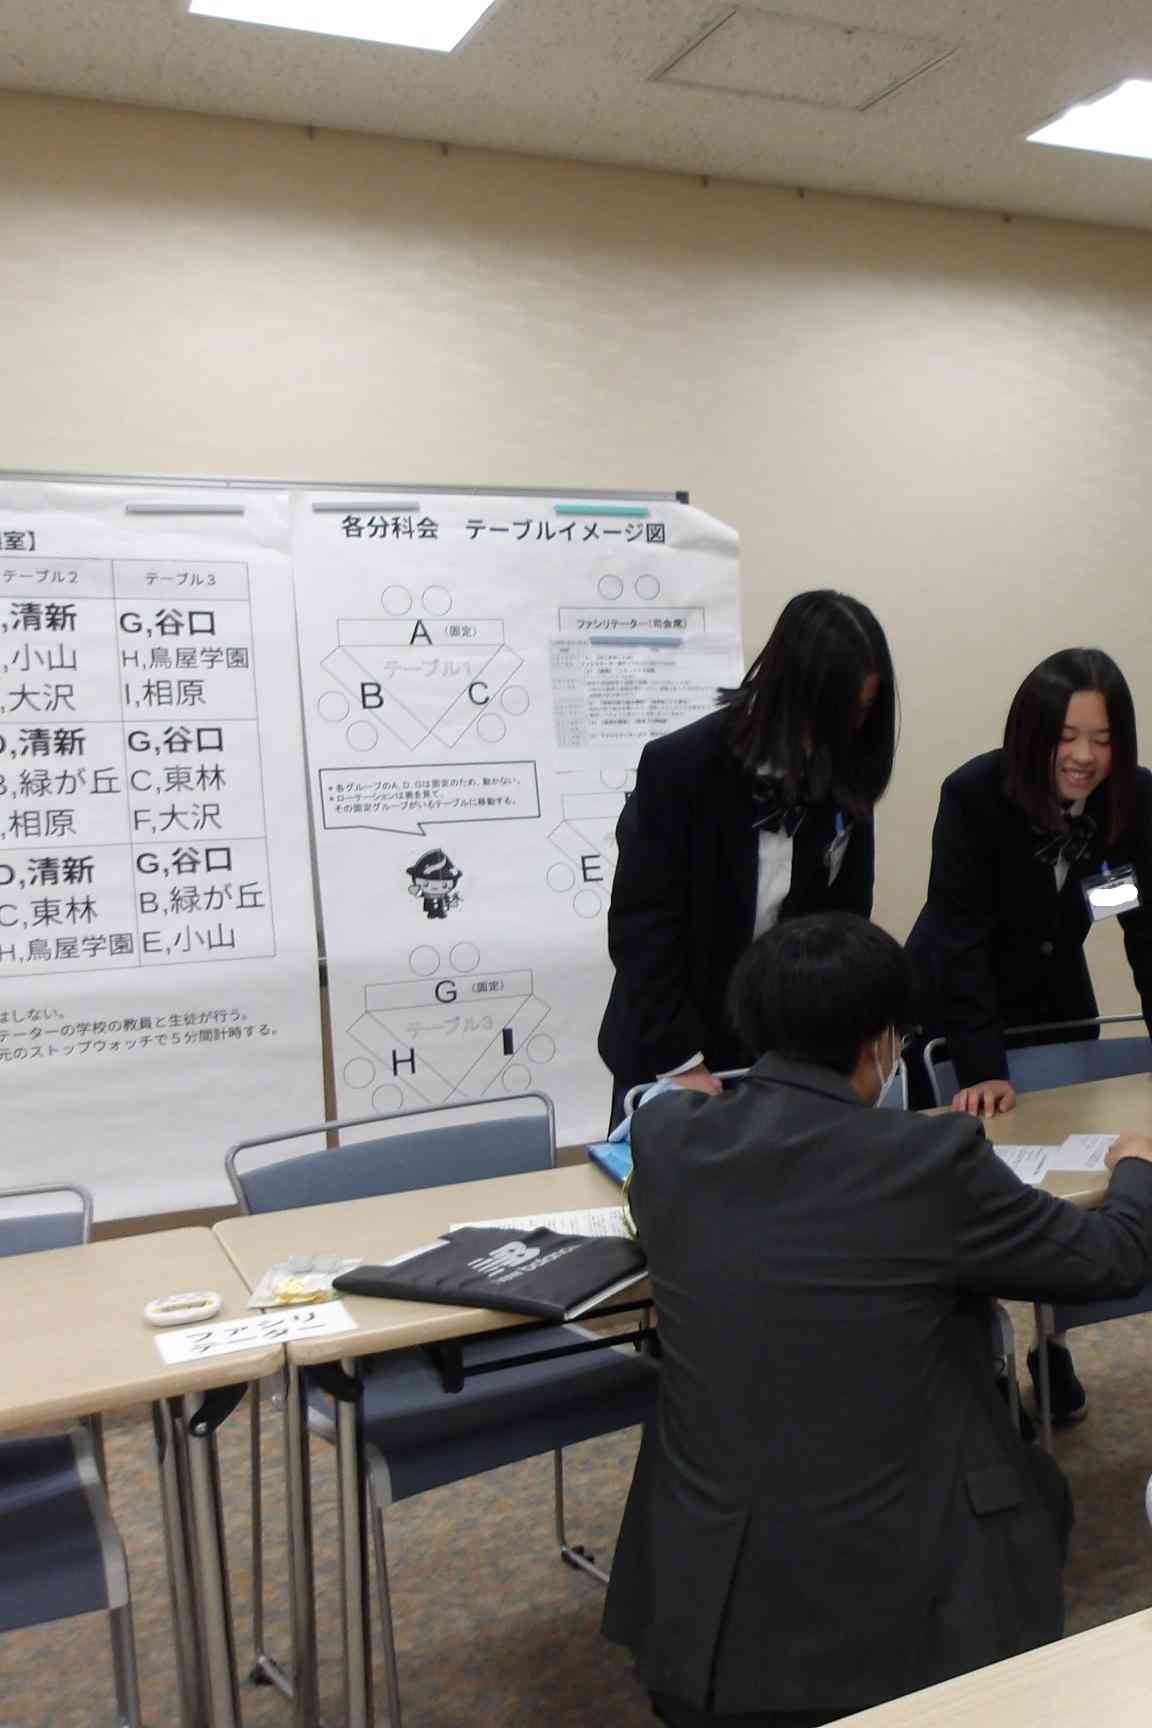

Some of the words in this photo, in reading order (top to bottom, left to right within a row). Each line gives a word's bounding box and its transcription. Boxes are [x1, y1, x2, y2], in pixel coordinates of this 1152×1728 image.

[0, 531, 35, 551] 室】
[341, 515, 439, 539] 各分科会
[465, 519, 666, 544] テーブルイメージ図
[3, 569, 79, 584] テーブル2
[145, 572, 216, 586] テーブル3
[120, 608, 216, 637] G,谷口
[409, 619, 433, 645] A
[121, 647, 249, 671] H,鳥屋学園
[360, 682, 384, 709] B
[468, 682, 490, 706] C
[127, 726, 225, 757] G,谷口
[130, 763, 227, 794] C,東林
[134, 803, 223, 834] F,大沢
[136, 847, 233, 877] G,谷口
[581, 855, 604, 882] E
[140, 882, 265, 916] B,緑が丘
[143, 923, 236, 955] E,小山
[434, 980, 457, 1003] G
[502, 1027, 514, 1056] I
[392, 1047, 416, 1077] H
